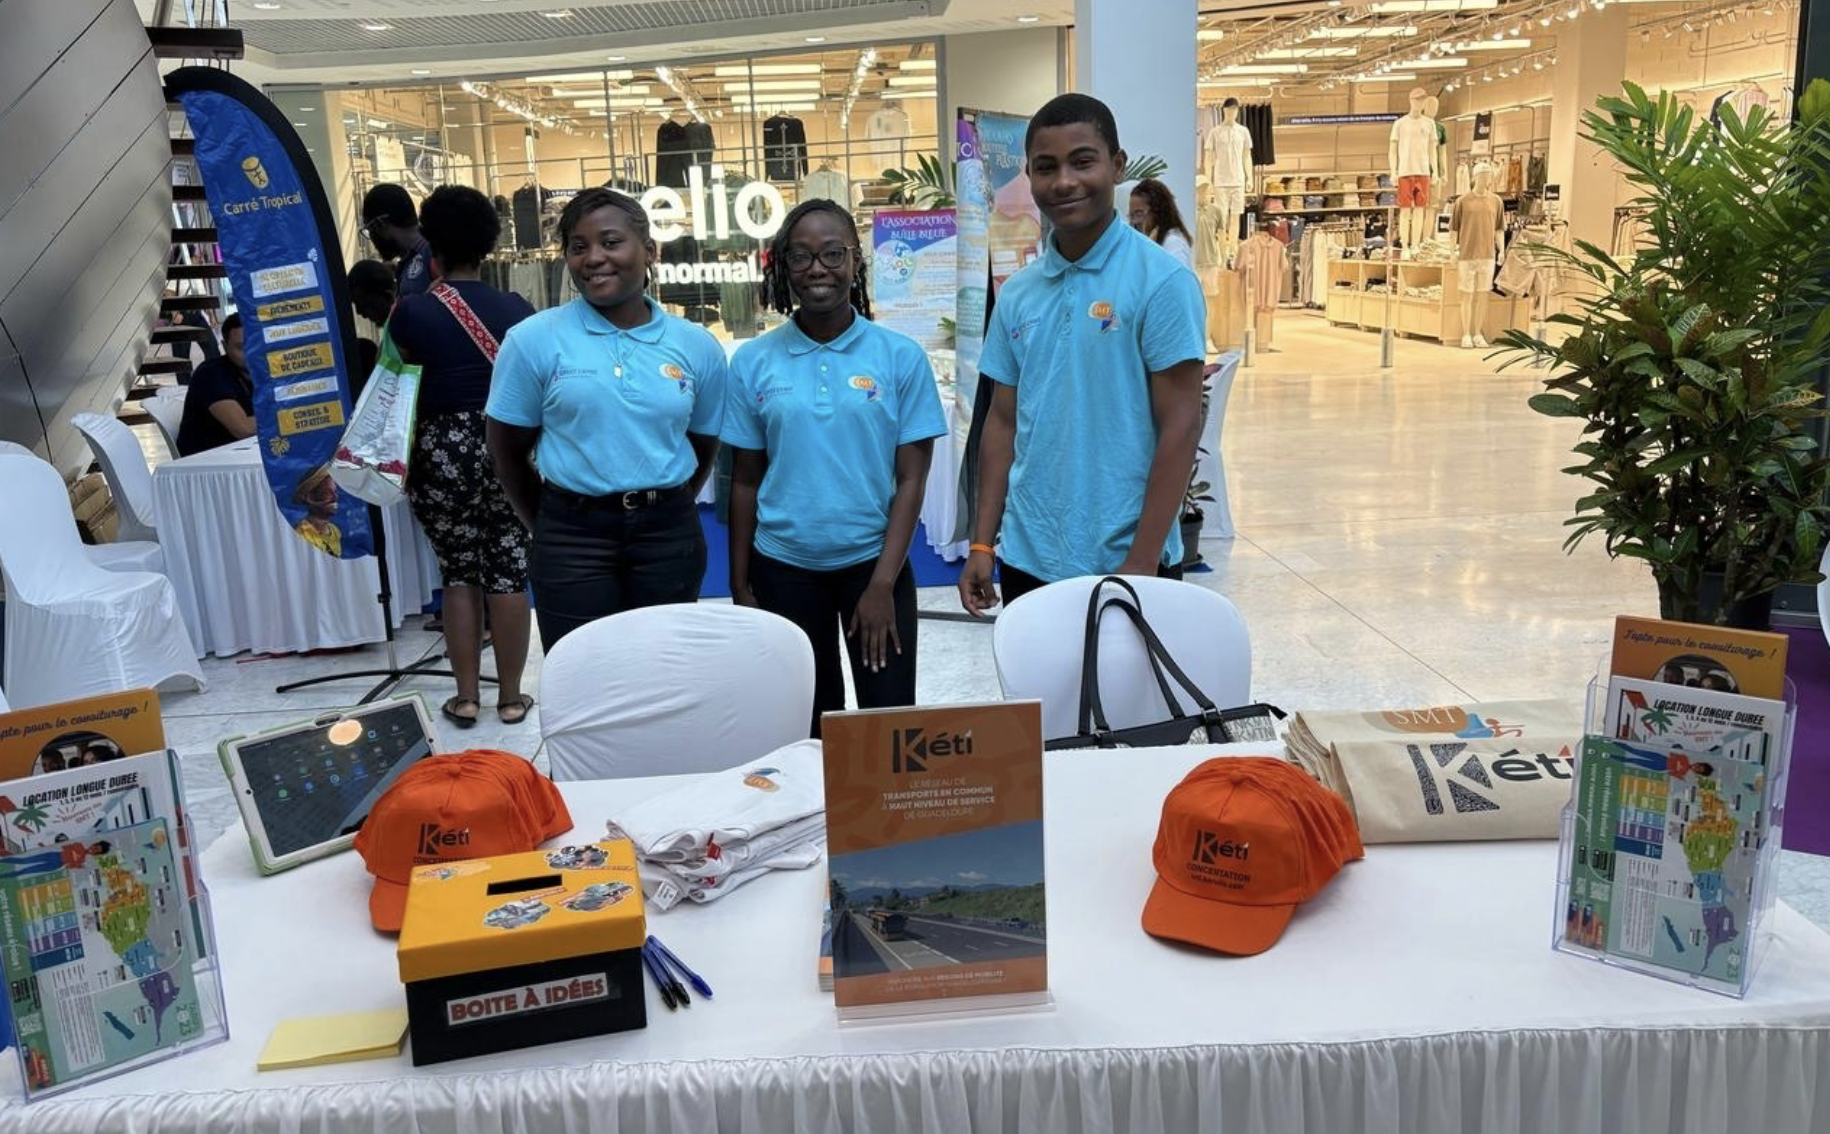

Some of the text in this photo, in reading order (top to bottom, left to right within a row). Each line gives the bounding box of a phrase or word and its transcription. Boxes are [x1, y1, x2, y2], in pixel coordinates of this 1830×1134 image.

[223, 191, 303, 215] Carré Tropical
[638, 164, 786, 243] elio
[881, 214, 958, 228] L'ASSOCIATION
[1397, 705, 1460, 726] SMT
[1653, 698, 1698, 715] LOCATION
[1697, 705, 1734, 721] LONGUE
[22, 722, 53, 737] pour
[891, 727, 973, 774] Kéti
[22, 786, 69, 807] LOCATION
[70, 778, 107, 797] LONGUE
[882, 786, 995, 801] TRANSPORTS EN COMMUN
[889, 801, 912, 811] HAUT
[913, 799, 946, 809] NIVEAU
[947, 798, 959, 806] DE
[960, 795, 995, 806] SERVICE
[418, 823, 470, 855] Kéti
[1192, 829, 1250, 865] Kéti
[451, 978, 604, 1022] BOITE À IDÉES
